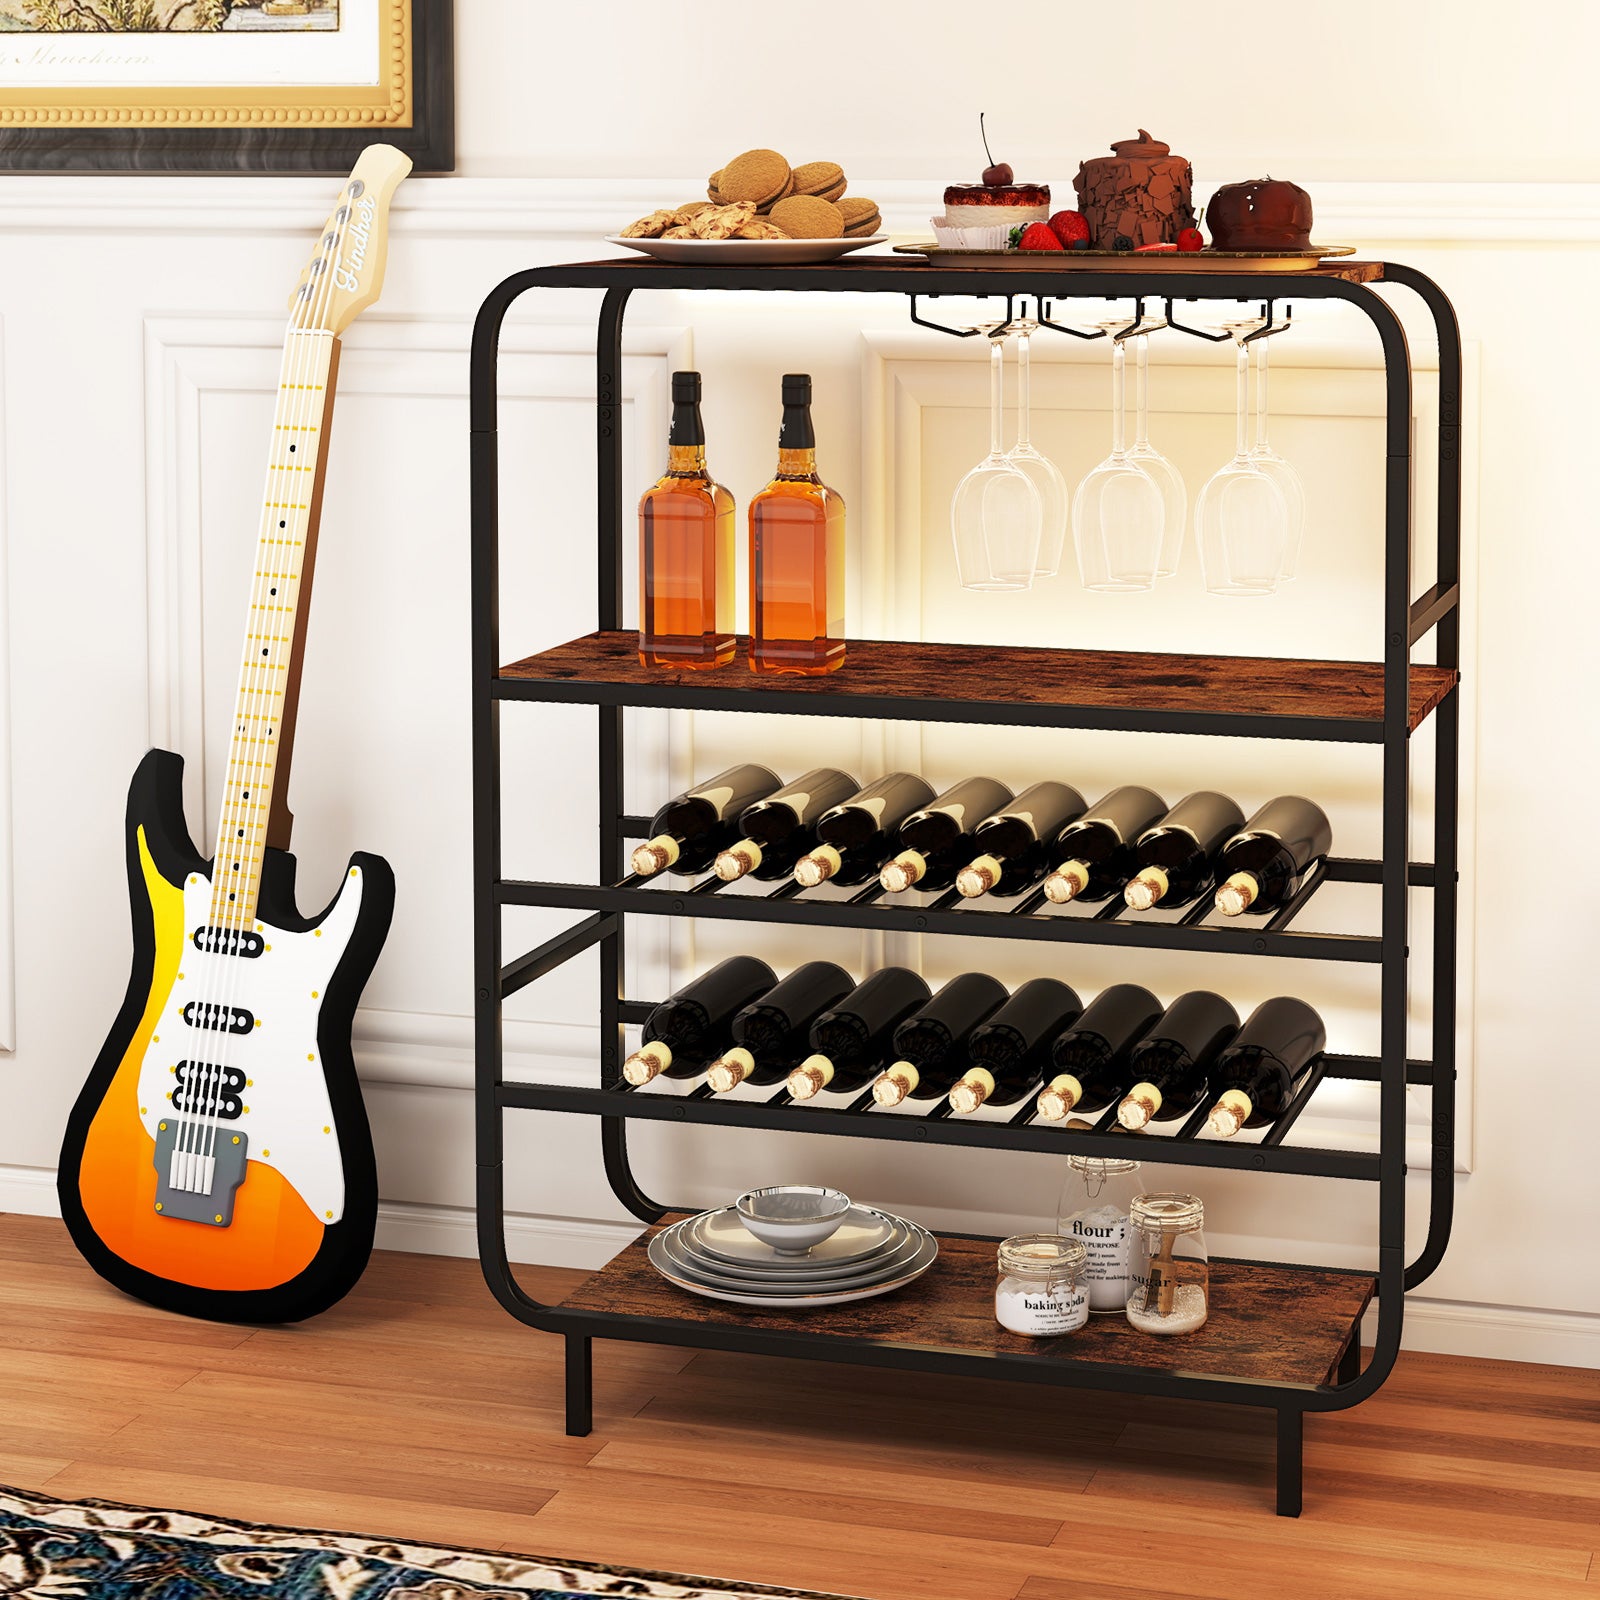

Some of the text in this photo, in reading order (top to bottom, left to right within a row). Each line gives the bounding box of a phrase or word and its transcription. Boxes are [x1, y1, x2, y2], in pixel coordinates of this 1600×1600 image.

[1073, 1220, 1114, 1238] flour
[1131, 1274, 1171, 1290] sugar
[1025, 1295, 1085, 1312] baking soda
